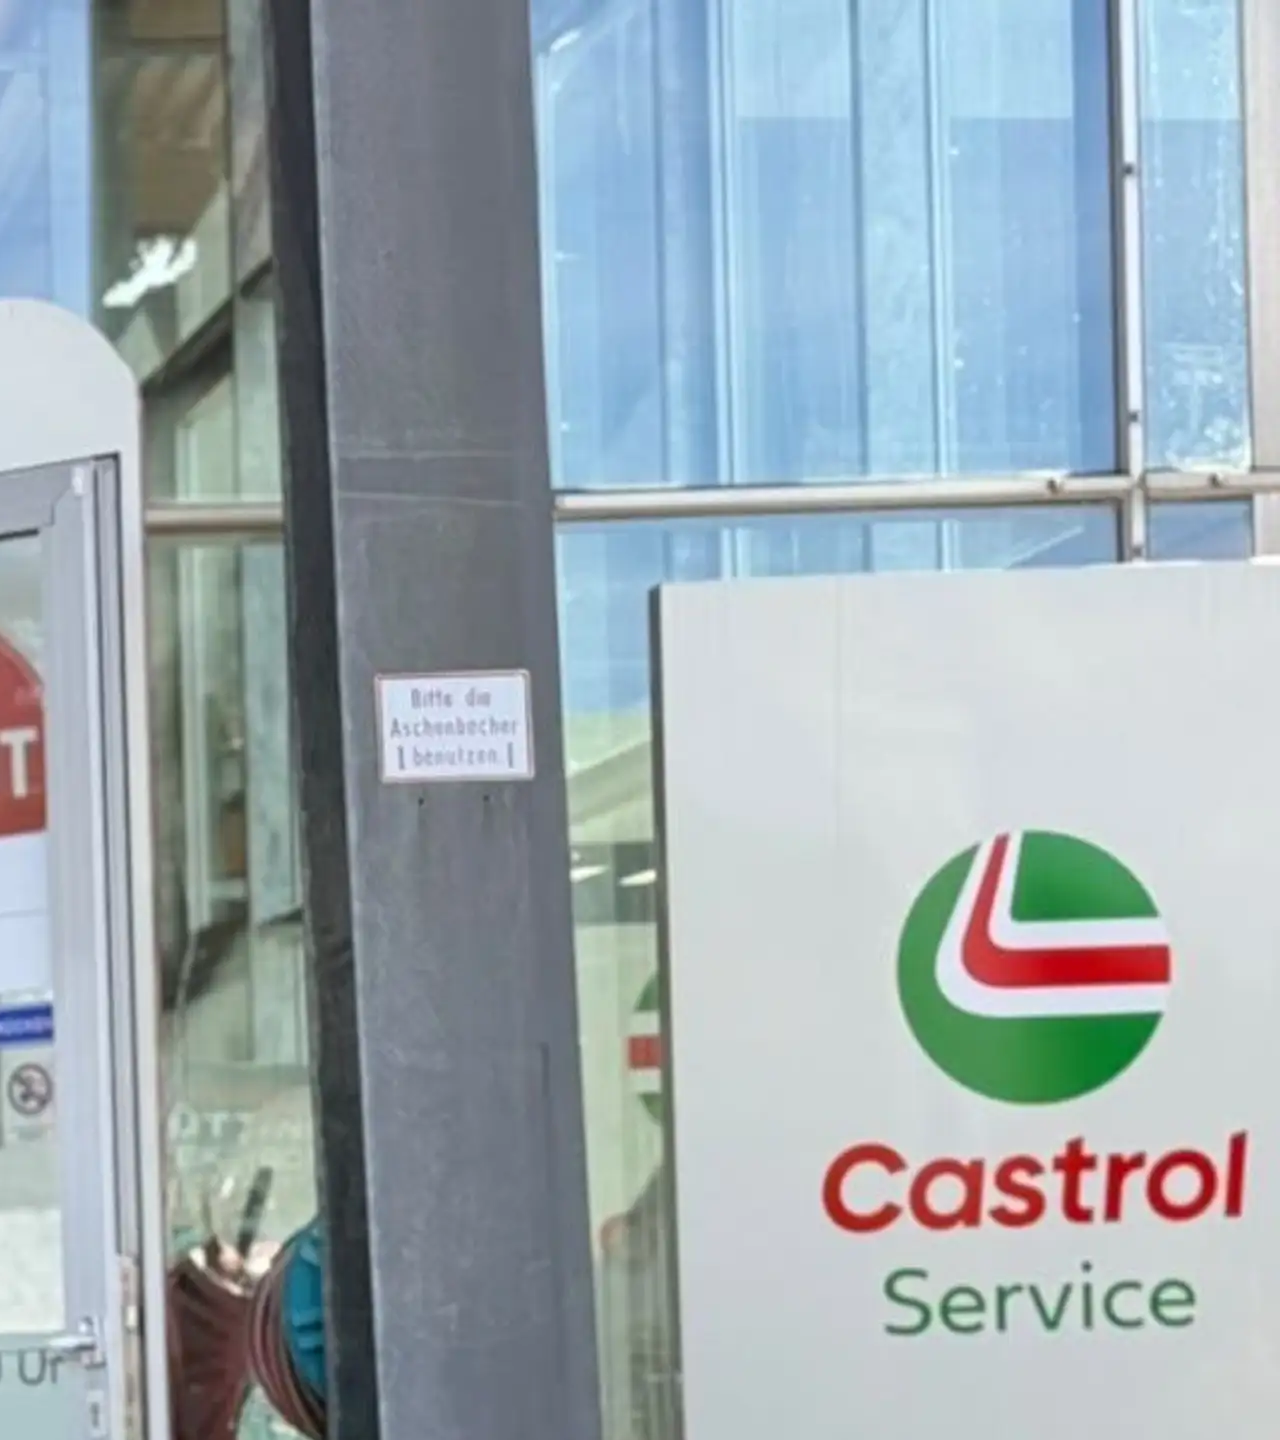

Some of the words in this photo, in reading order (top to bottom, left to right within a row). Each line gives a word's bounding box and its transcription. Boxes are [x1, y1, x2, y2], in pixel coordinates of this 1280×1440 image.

[411, 688, 453, 710] Bitte
[466, 687, 491, 708] die
[822, 1130, 1248, 1233] Castrol
[884, 1261, 1196, 1336] Service
